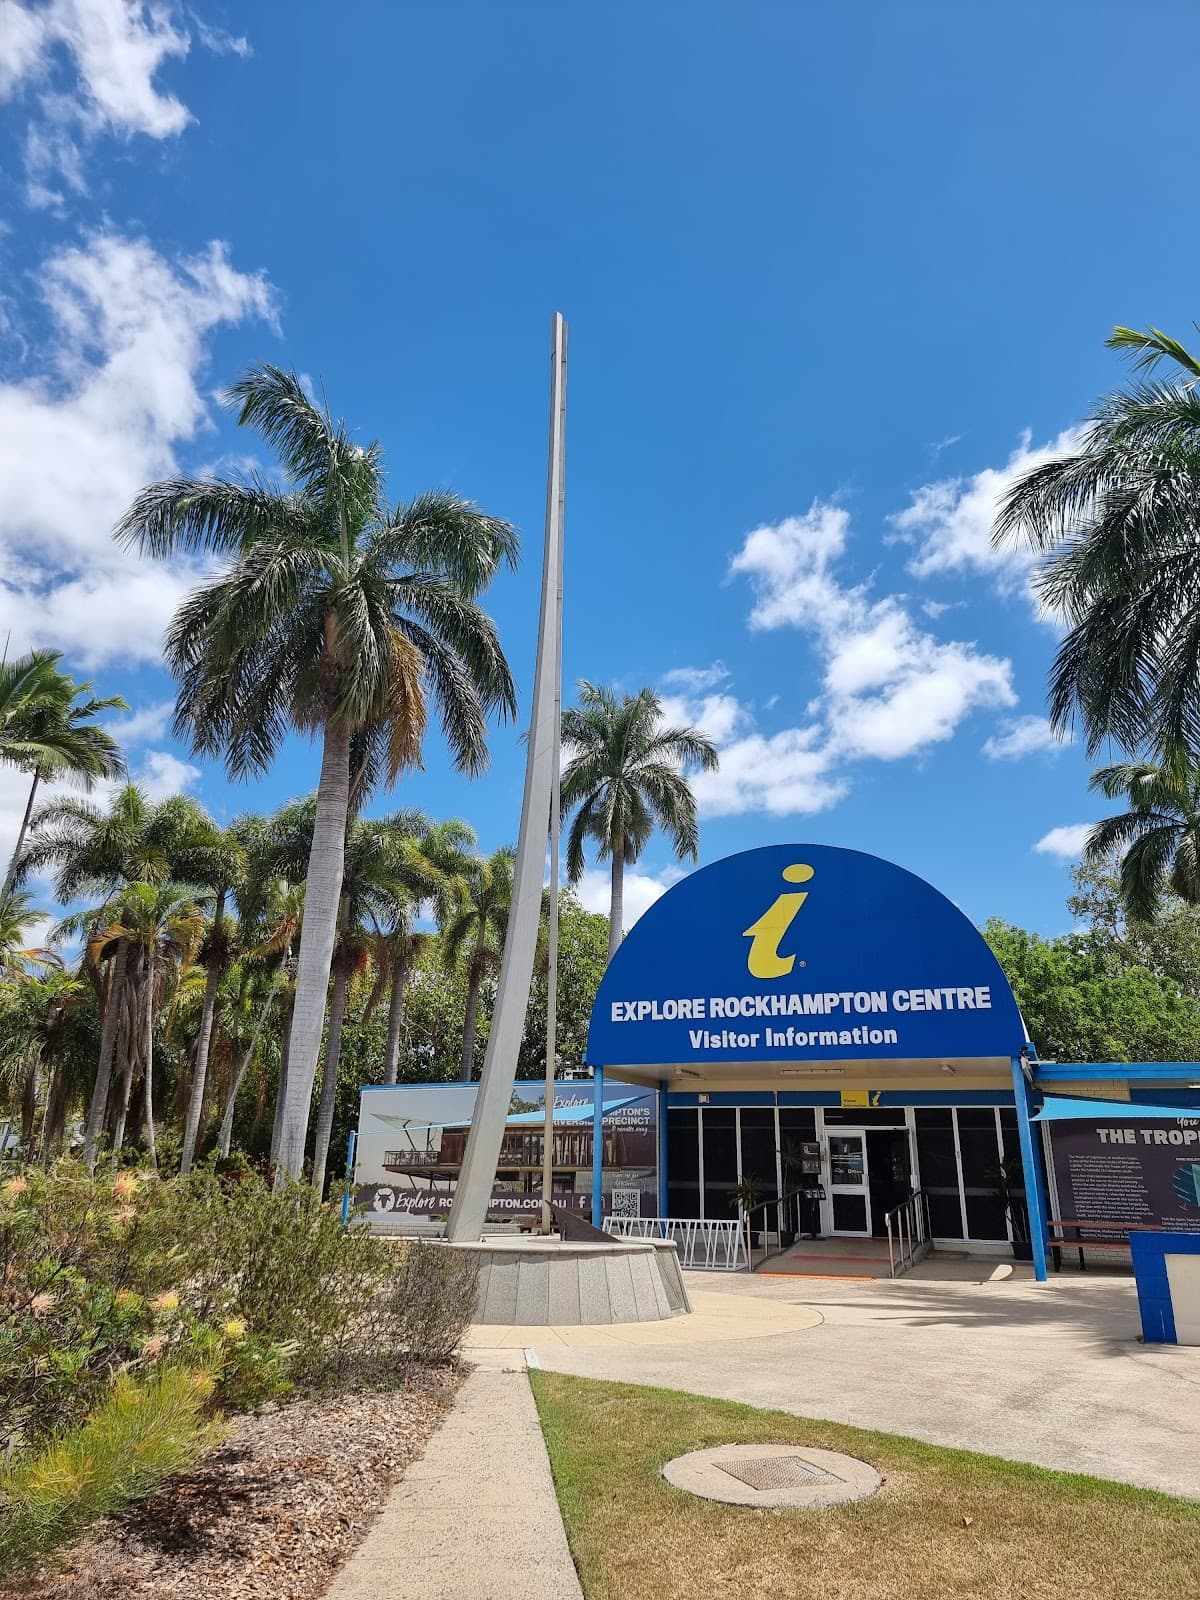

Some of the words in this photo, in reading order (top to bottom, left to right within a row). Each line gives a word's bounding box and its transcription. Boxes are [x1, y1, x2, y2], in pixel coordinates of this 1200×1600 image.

[610, 999, 706, 1022] EXPLORE
[709, 990, 889, 1019] ROCKHAMPTON
[891, 985, 993, 1013] CENTRE
[688, 1029, 760, 1050] Visitor
[765, 1024, 898, 1048] Information
[602, 1116, 651, 1126] PRECINCT
[1096, 1128, 1137, 1145] THE
[395, 1190, 437, 1213] Explore
